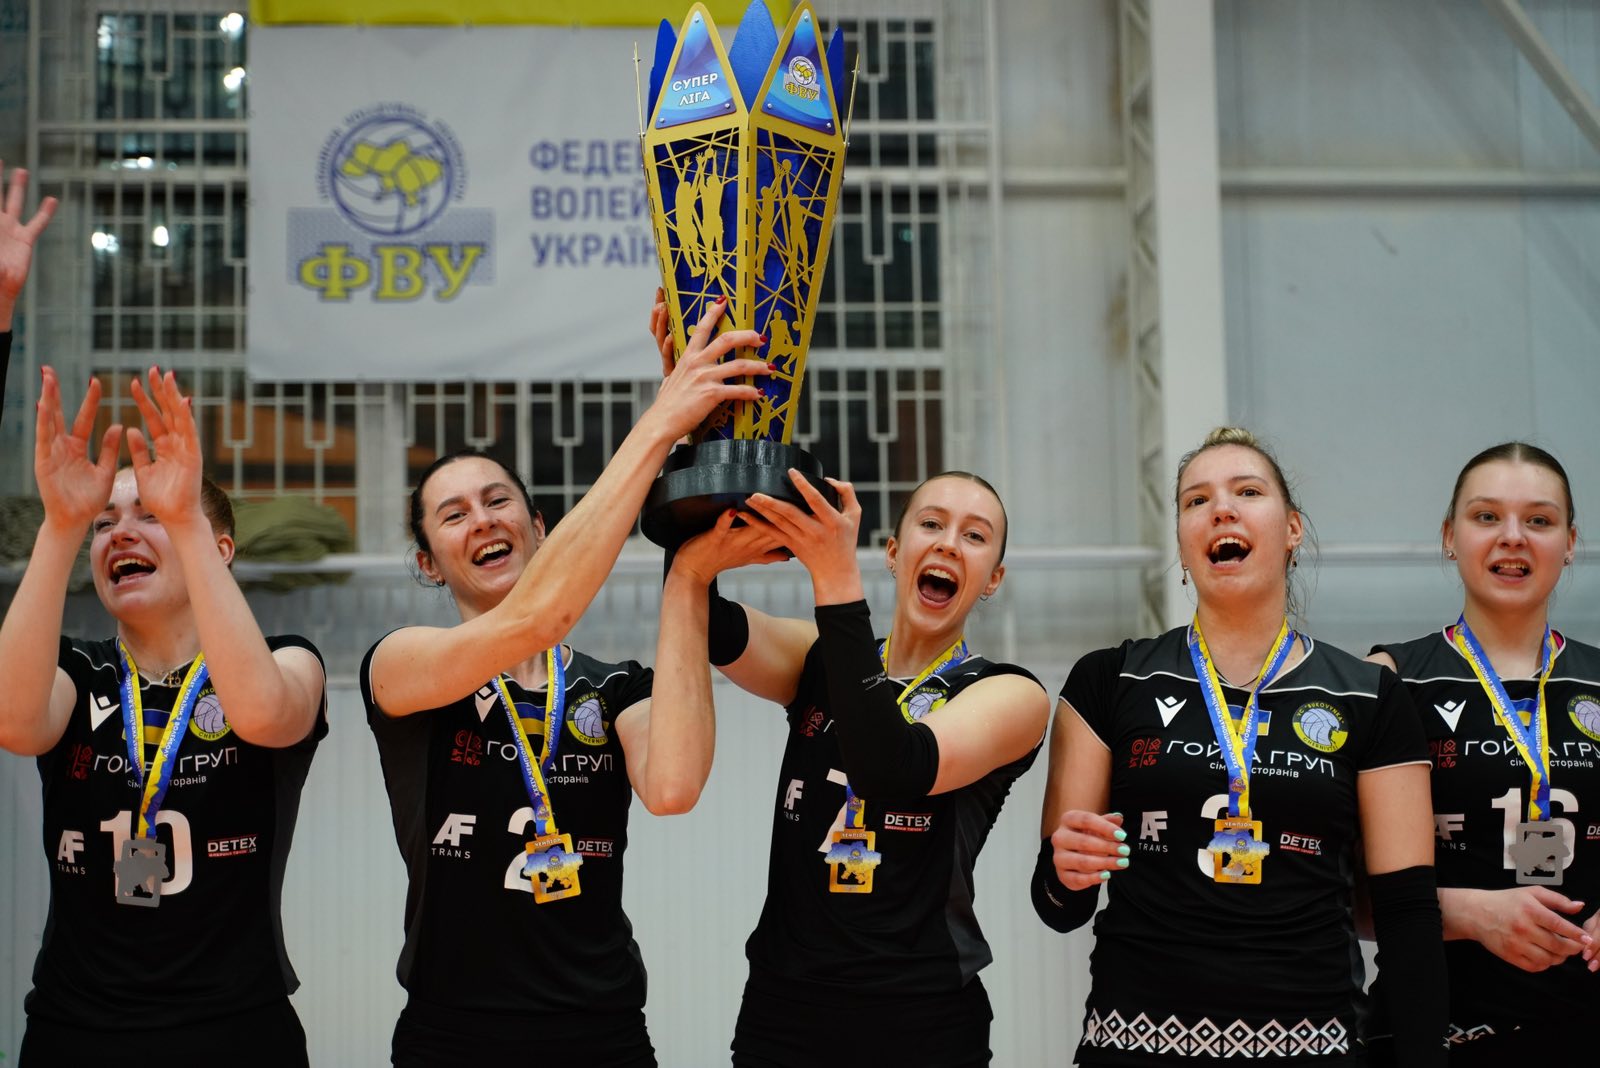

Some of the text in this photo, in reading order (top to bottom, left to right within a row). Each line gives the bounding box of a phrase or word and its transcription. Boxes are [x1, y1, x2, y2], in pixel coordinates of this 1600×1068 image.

[672, 72, 718, 92] СУПЕР
[785, 81, 819, 102] ФВУ
[678, 91, 711, 107] ЛІГА
[299, 242, 486, 303] ФВУ
[179, 746, 239, 774] ГРУП
[562, 754, 613, 772] ГРУП
[1166, 740, 1335, 778] ГОЙА ГРУП
[784, 779, 804, 811] AF
[432, 813, 477, 847] AF
[884, 813, 932, 827] DETEX
[1140, 810, 1169, 842] AF
[58, 830, 85, 864] AF
[207, 836, 257, 853] DETEX
[576, 840, 613, 852] DETEX
[1138, 842, 1169, 853] TRANS
[1280, 833, 1322, 850] DETEX
[431, 847, 471, 860] TRANS
